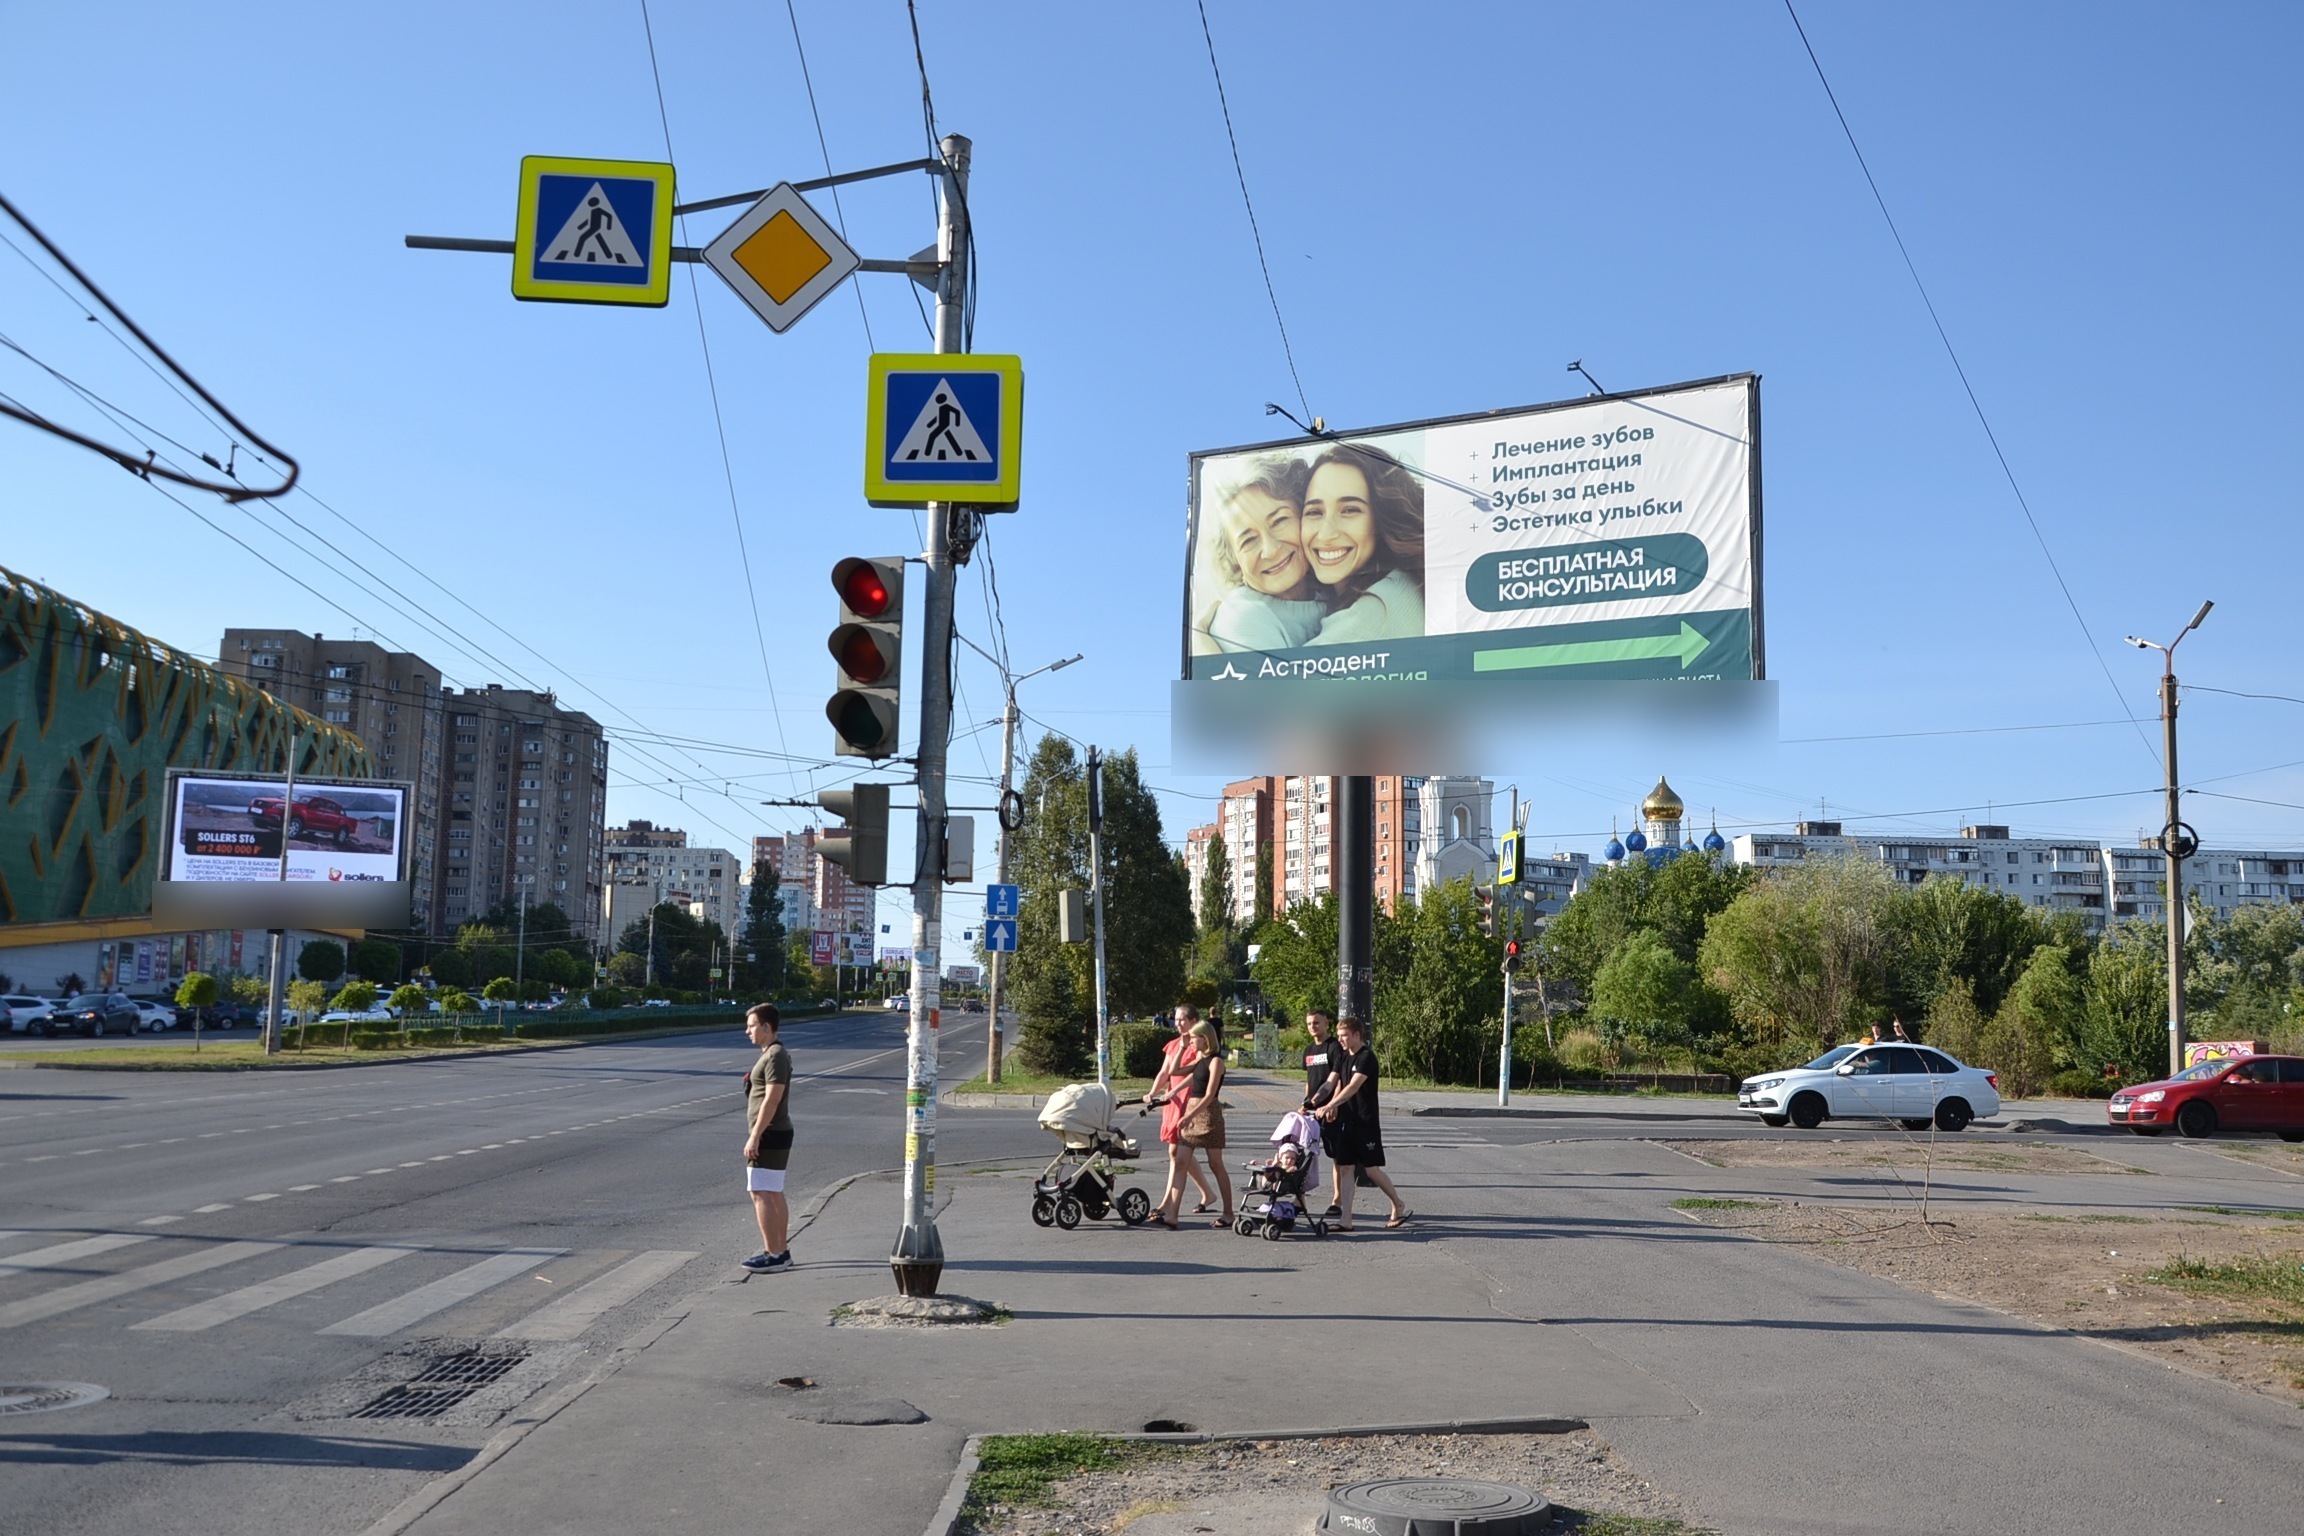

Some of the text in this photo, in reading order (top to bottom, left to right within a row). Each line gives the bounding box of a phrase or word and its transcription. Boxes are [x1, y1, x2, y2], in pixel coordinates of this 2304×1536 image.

[1491, 424, 1655, 460] Лечение зубов
[1491, 452, 1642, 483] Имплантация
[1491, 479, 1635, 511] Зубы за день
[1491, 497, 1683, 533] Эстетика улыбки
[1498, 547, 1644, 580] БЕСПЛАТНАЯ
[1498, 566, 1677, 601] КОНСУЛЬТАЦИЯ
[1258, 652, 1390, 679] Астродент
[197, 832, 256, 844] SOLLERS ST6
[344, 873, 384, 881] sollers
